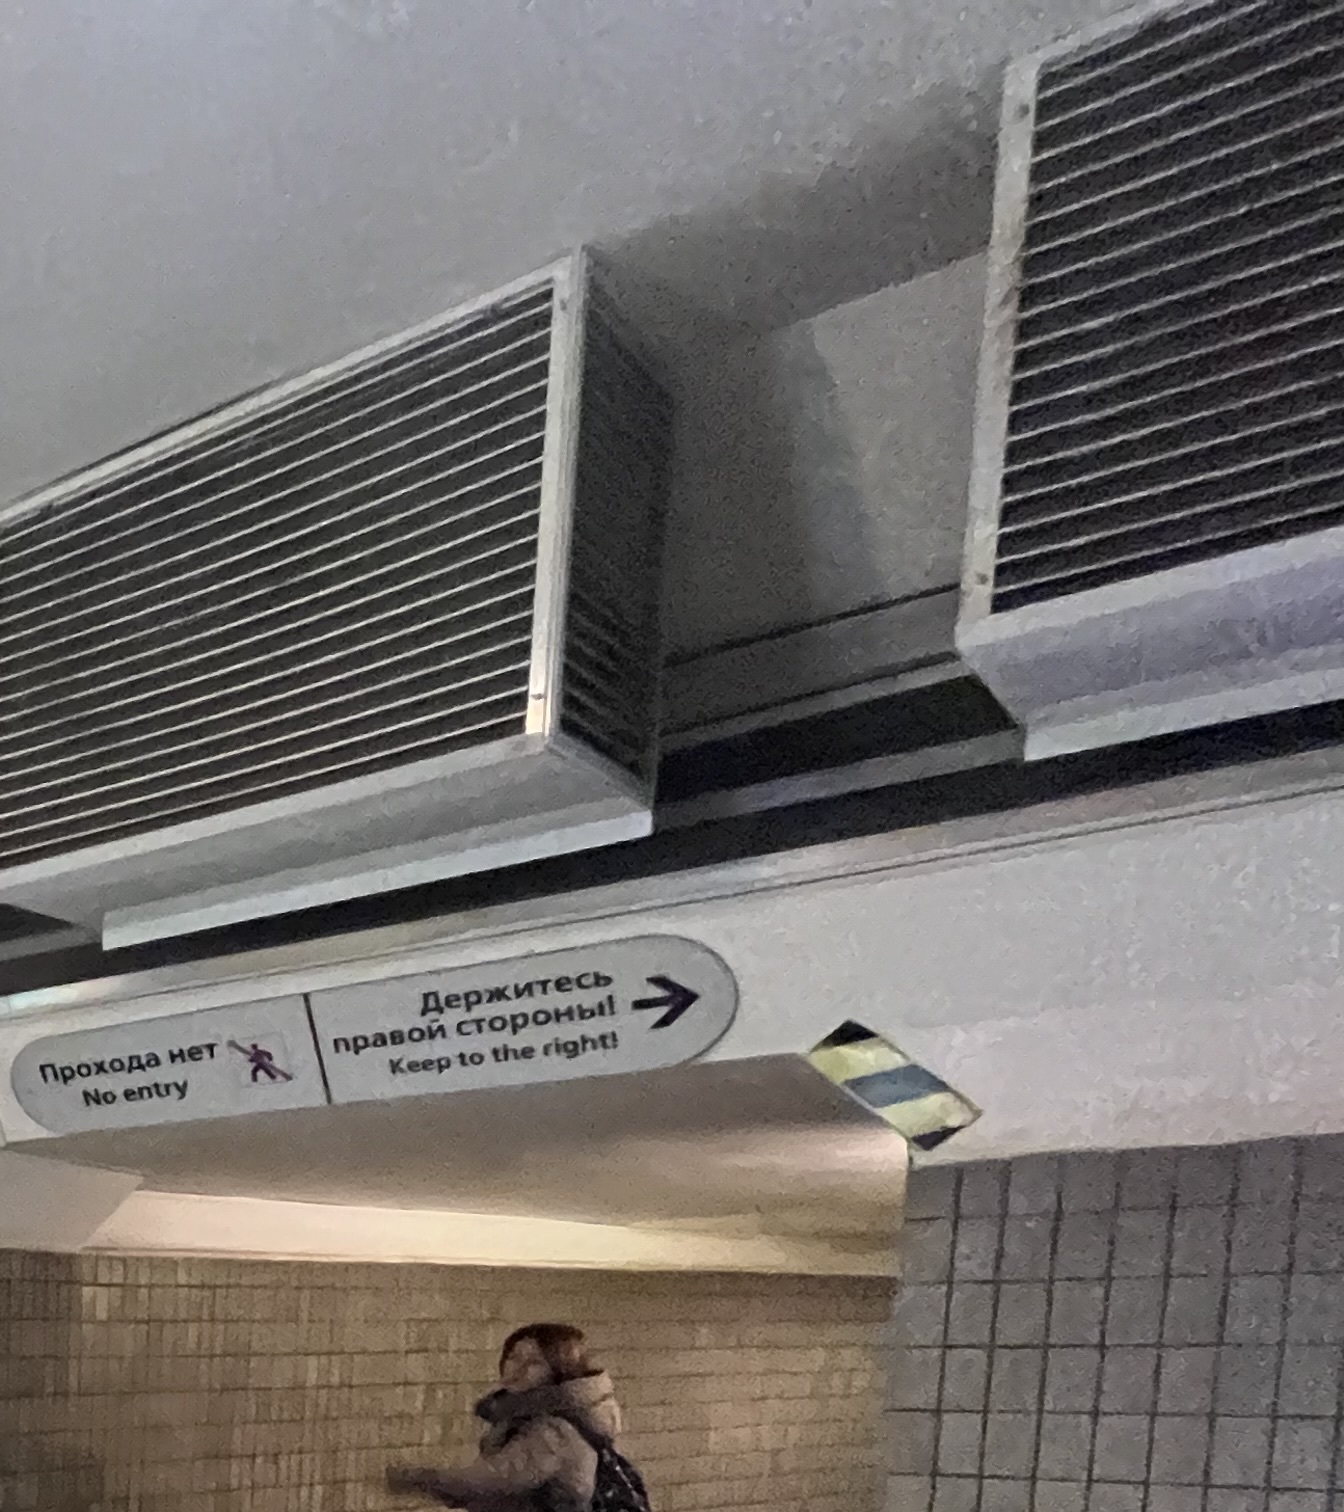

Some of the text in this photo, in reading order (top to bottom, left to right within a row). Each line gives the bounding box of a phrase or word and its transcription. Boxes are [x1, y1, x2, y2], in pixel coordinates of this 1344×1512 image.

[420, 970, 613, 1017] Держитесь
[332, 994, 617, 1055] правой стороны!
[38, 1042, 218, 1086] Прохода нет
[389, 1030, 619, 1076] Keep to the right!
[81, 1079, 189, 1107] No entry
